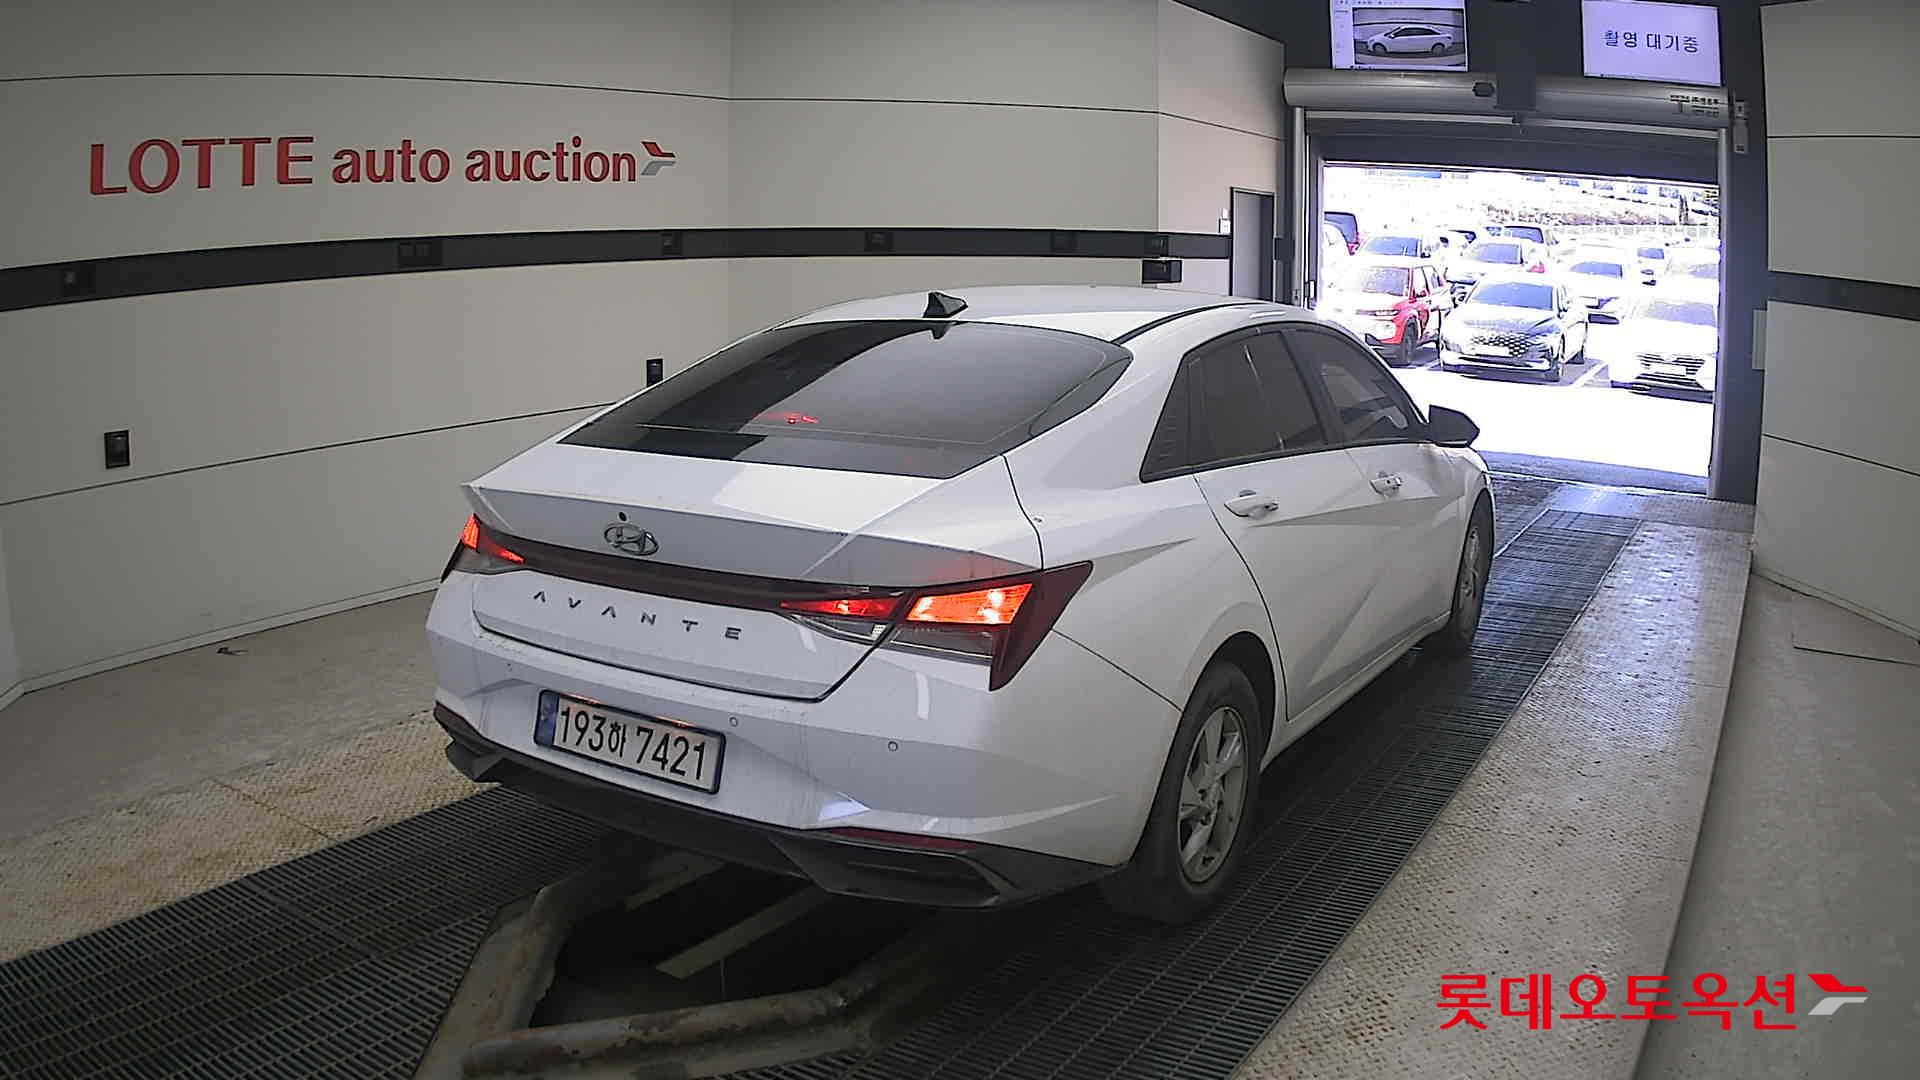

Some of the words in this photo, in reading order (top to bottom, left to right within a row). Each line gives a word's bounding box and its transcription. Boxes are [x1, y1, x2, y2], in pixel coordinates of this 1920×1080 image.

[1646, 33, 1698, 53] 대기중
[90, 136, 314, 195] LOTTE
[331, 139, 450, 184] auto
[464, 136, 637, 183] auction
[533, 591, 742, 640] AVANTE
[560, 706, 627, 758] 193하
[636, 726, 707, 780] 7421
